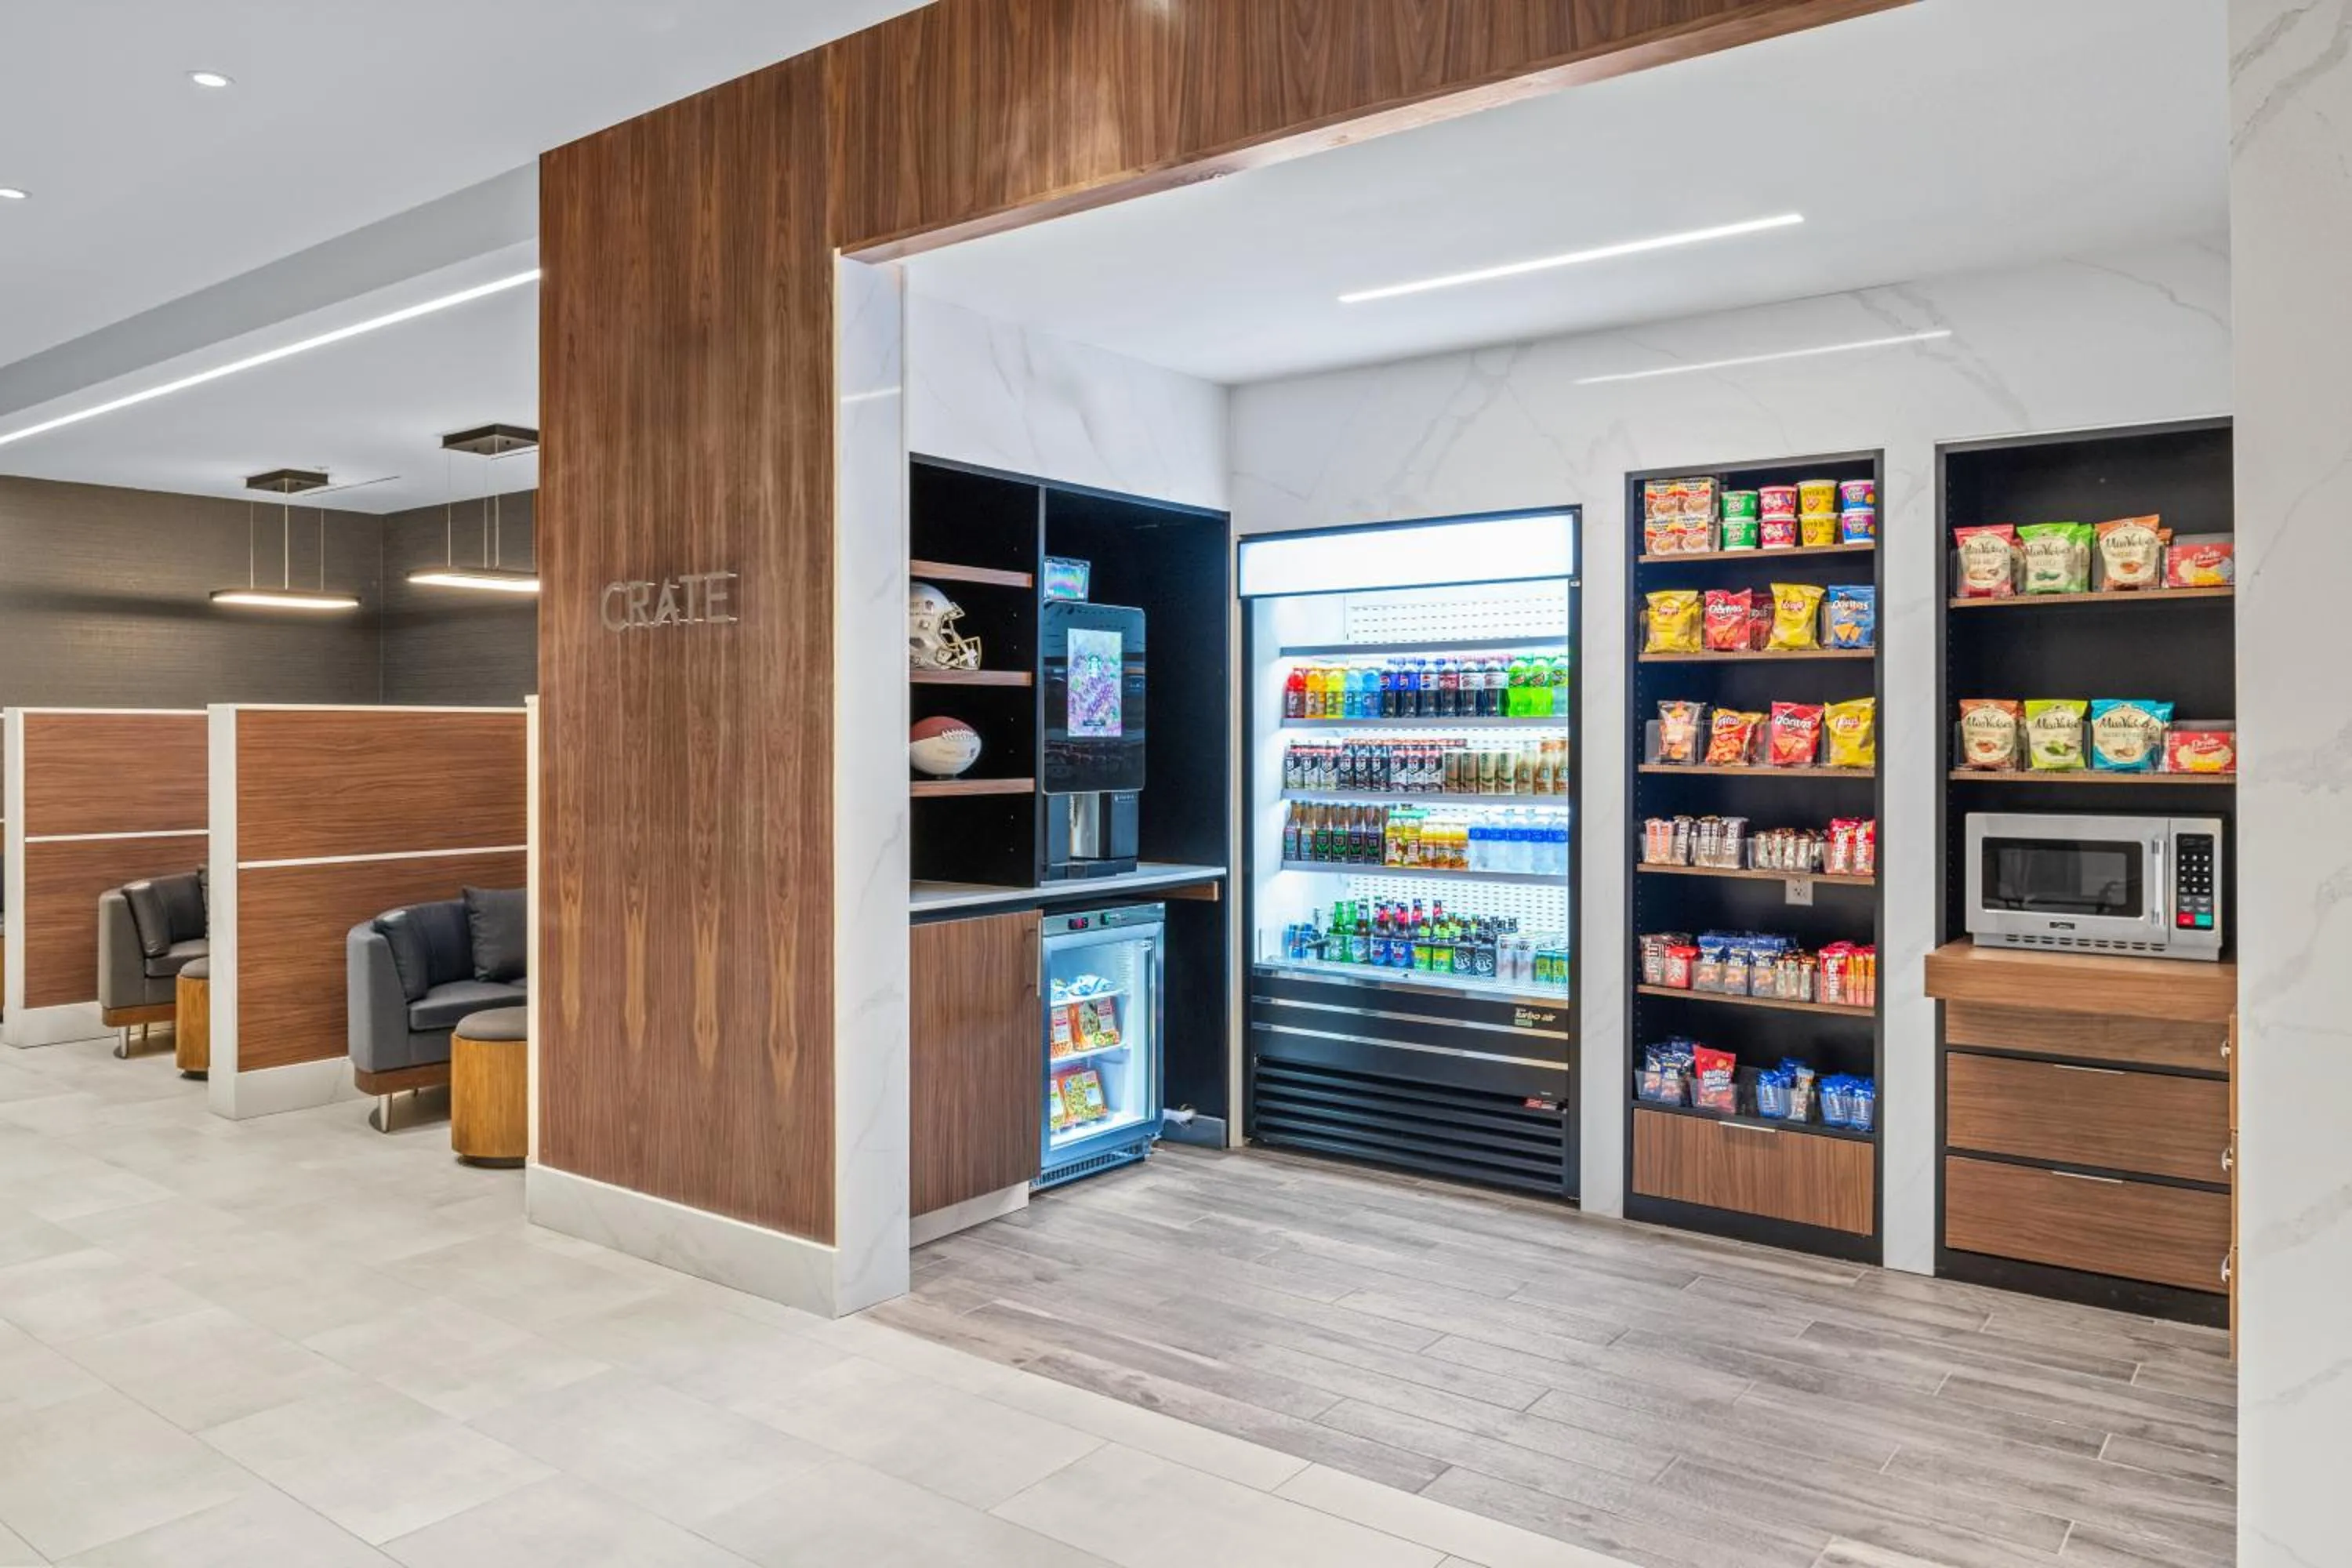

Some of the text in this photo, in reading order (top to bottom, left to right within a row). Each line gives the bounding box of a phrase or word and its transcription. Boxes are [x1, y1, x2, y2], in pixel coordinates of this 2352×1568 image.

[601, 572, 736, 633] CRATE
[1831, 598, 1869, 612] Doritos
[1774, 714, 1813, 730] Doritos
